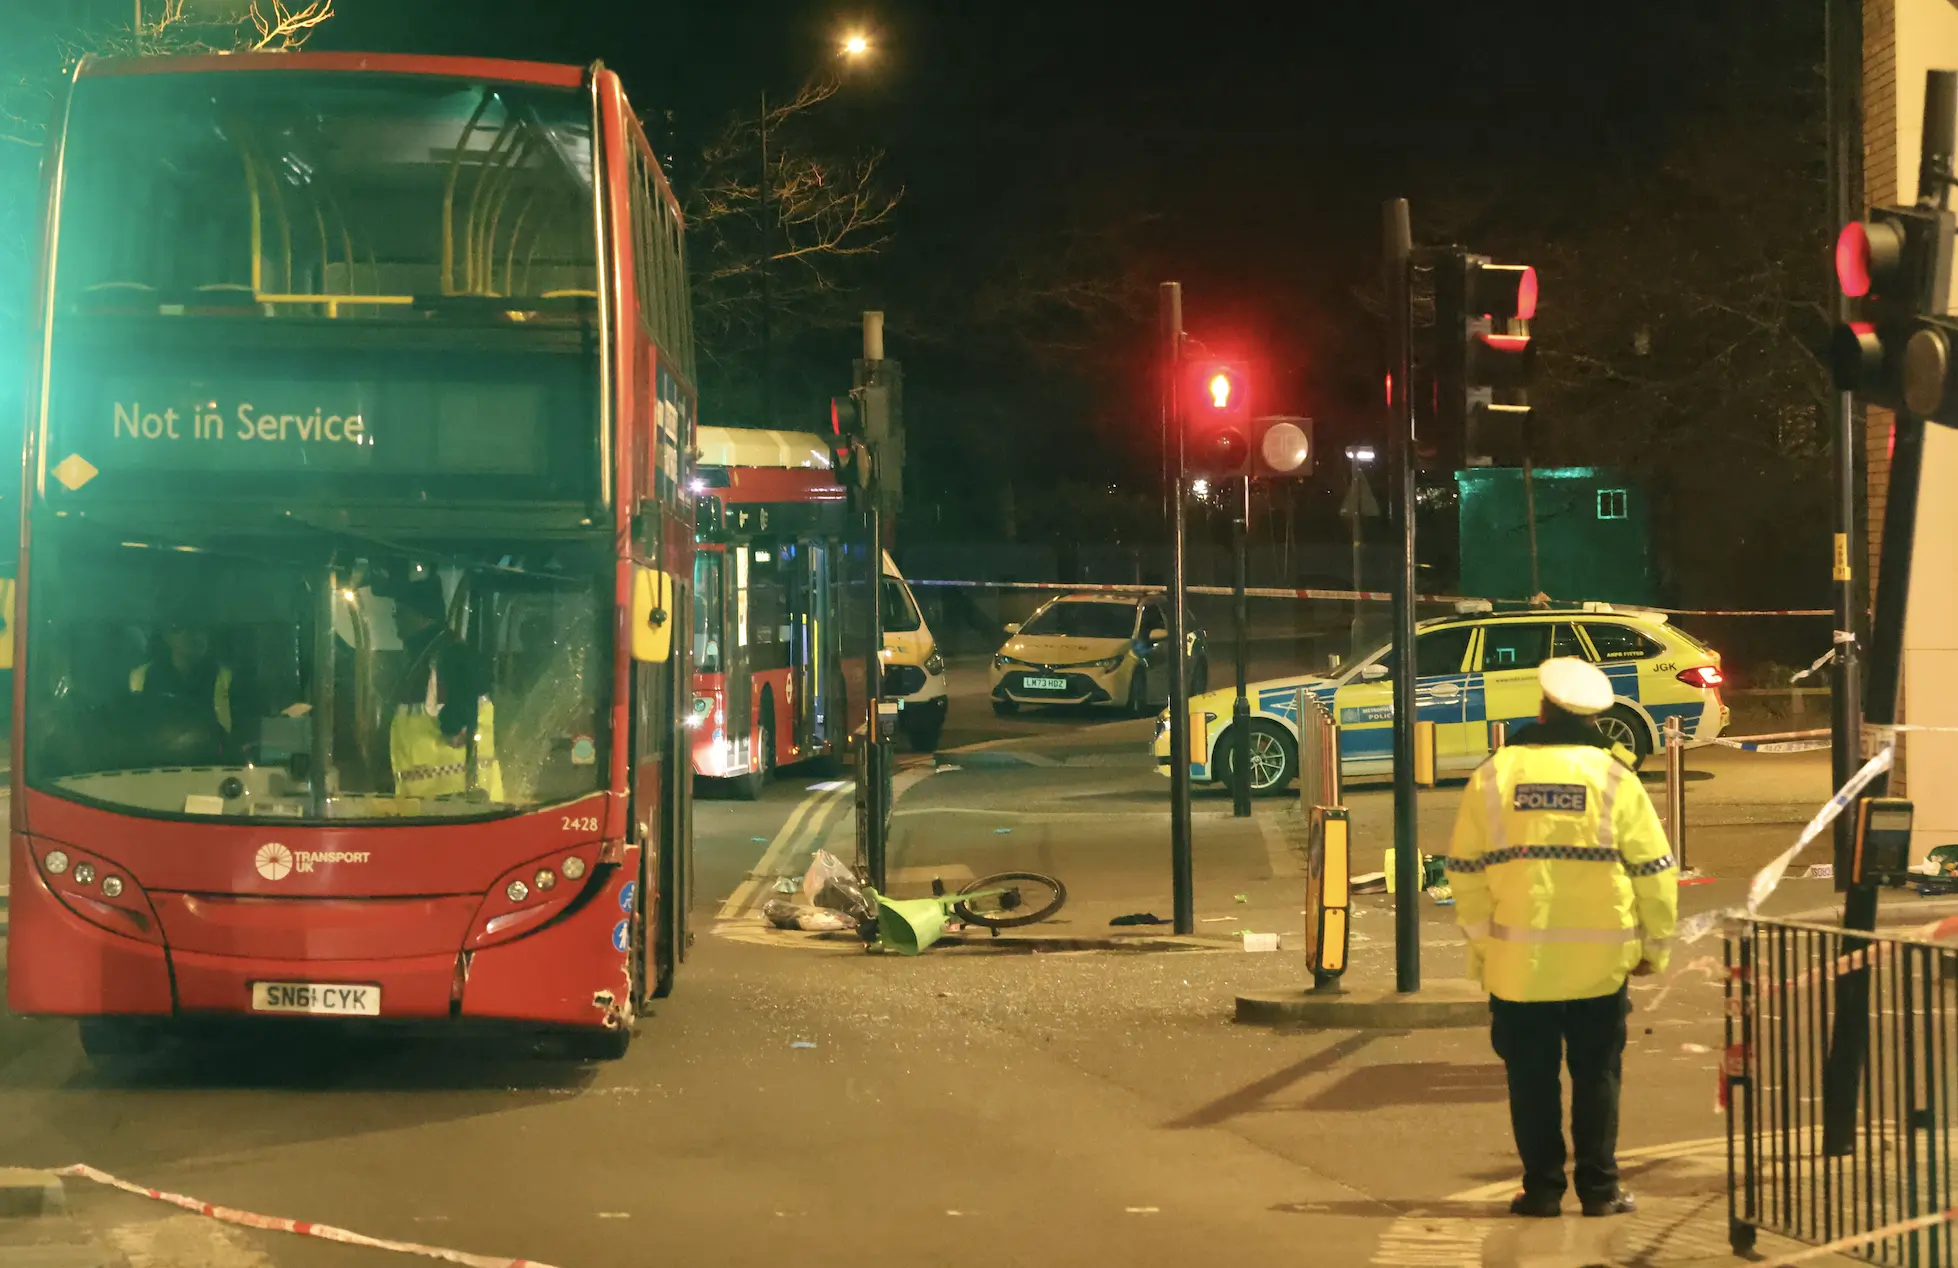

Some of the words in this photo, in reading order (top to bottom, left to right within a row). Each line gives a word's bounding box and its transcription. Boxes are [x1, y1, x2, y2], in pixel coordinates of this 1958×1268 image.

[114, 401, 180, 439] Not
[194, 403, 223, 440] in
[237, 403, 364, 442] Service
[1653, 662, 1677, 673] JGK
[1026, 679, 1047, 687] LM73
[1048, 680, 1064, 688] HDZ
[1516, 793, 1583, 809] POLICE
[561, 817, 598, 832] 2428
[294, 851, 370, 864] TRANSPORT
[296, 863, 315, 873] UK
[323, 989, 367, 1010] CYK
